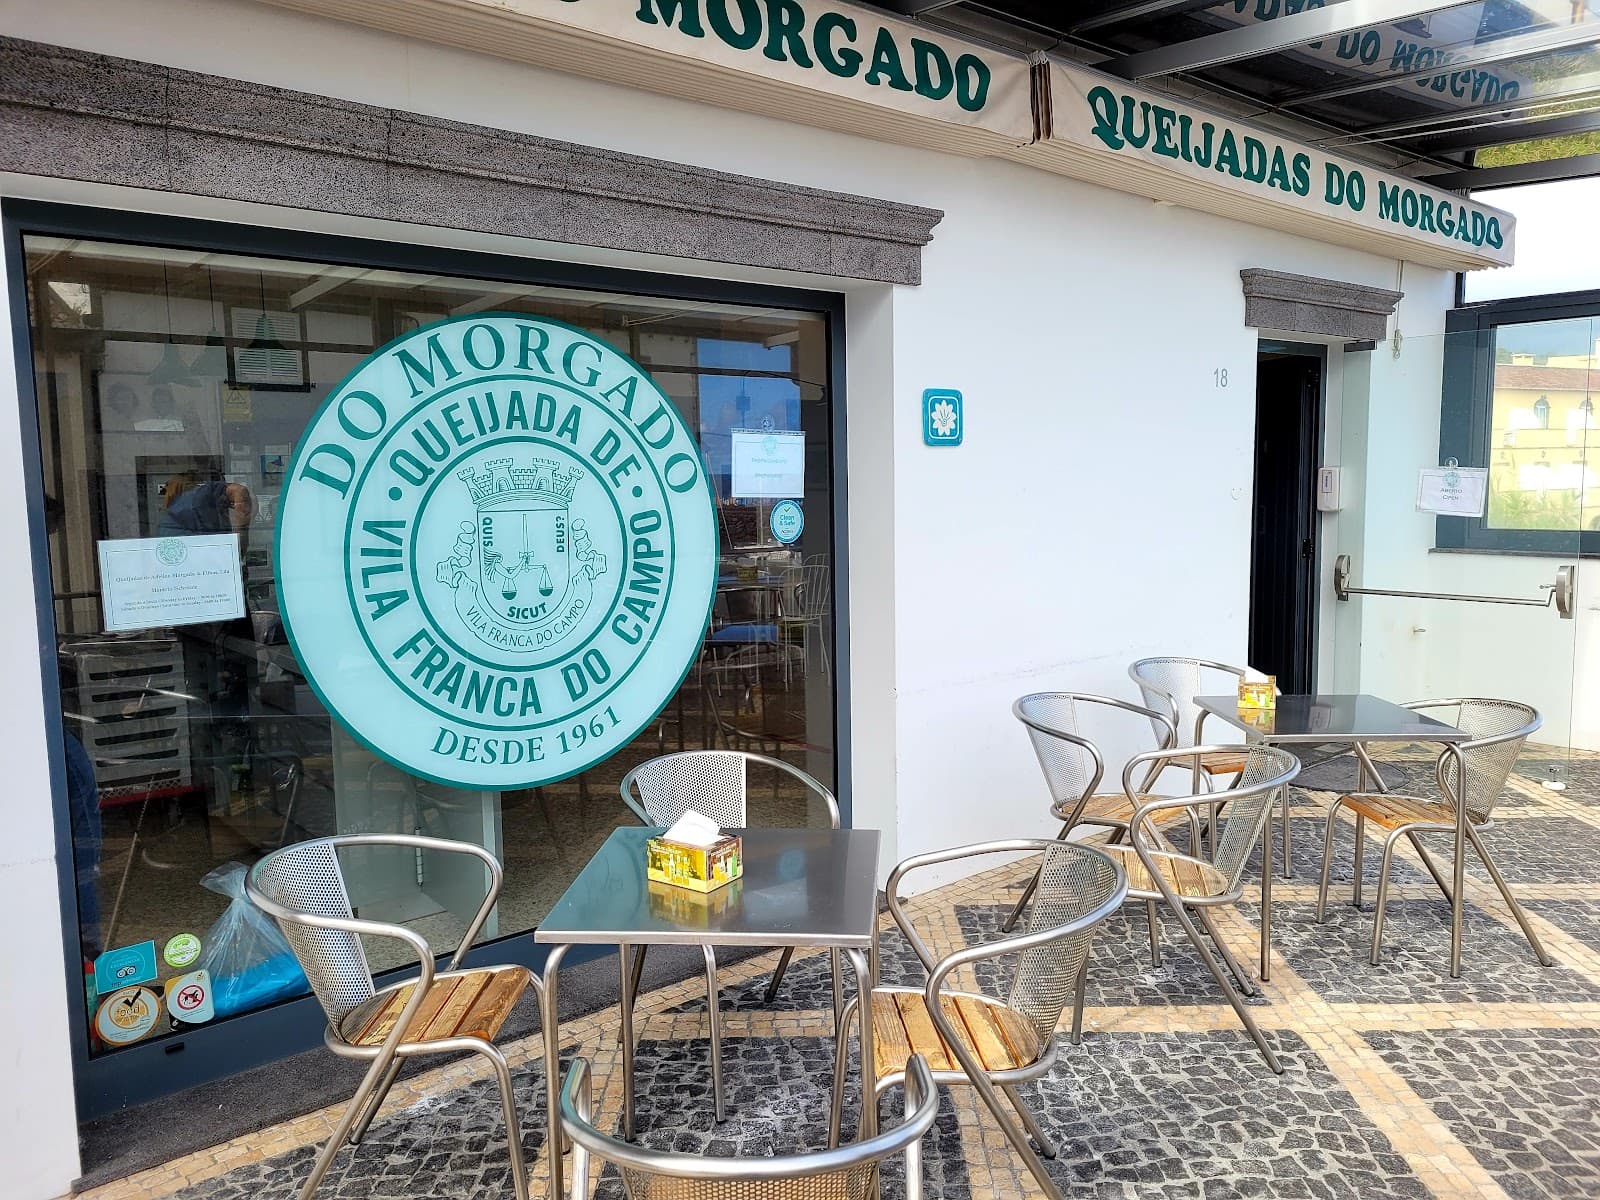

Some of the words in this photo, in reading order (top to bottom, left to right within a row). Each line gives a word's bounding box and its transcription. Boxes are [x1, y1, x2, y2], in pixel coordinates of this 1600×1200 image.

[1087, 86, 1311, 197] QUEIJADAS
[1324, 162, 1366, 212] DO
[1378, 180, 1504, 250] MORGADO
[1213, 367, 1228, 388] 18
[299, 390, 388, 500] DO
[392, 323, 698, 494] MORGADO
[388, 390, 582, 487] QUEIJADA
[588, 428, 643, 488] DE
[482, 517, 493, 548] QUIS
[556, 515, 565, 553] DEUS?
[360, 518, 410, 622] VILA
[392, 627, 543, 718] FRANCA
[562, 647, 612, 702] DO
[611, 509, 664, 645] CAMPO
[466, 604, 487, 634] VILA
[487, 626, 534, 647] FRANCA
[536, 628, 553, 645] DO
[553, 598, 585, 634] CAMPO
[507, 602, 548, 619] SICUT
[430, 726, 546, 766] DESDE
[555, 705, 622, 754] 1961
